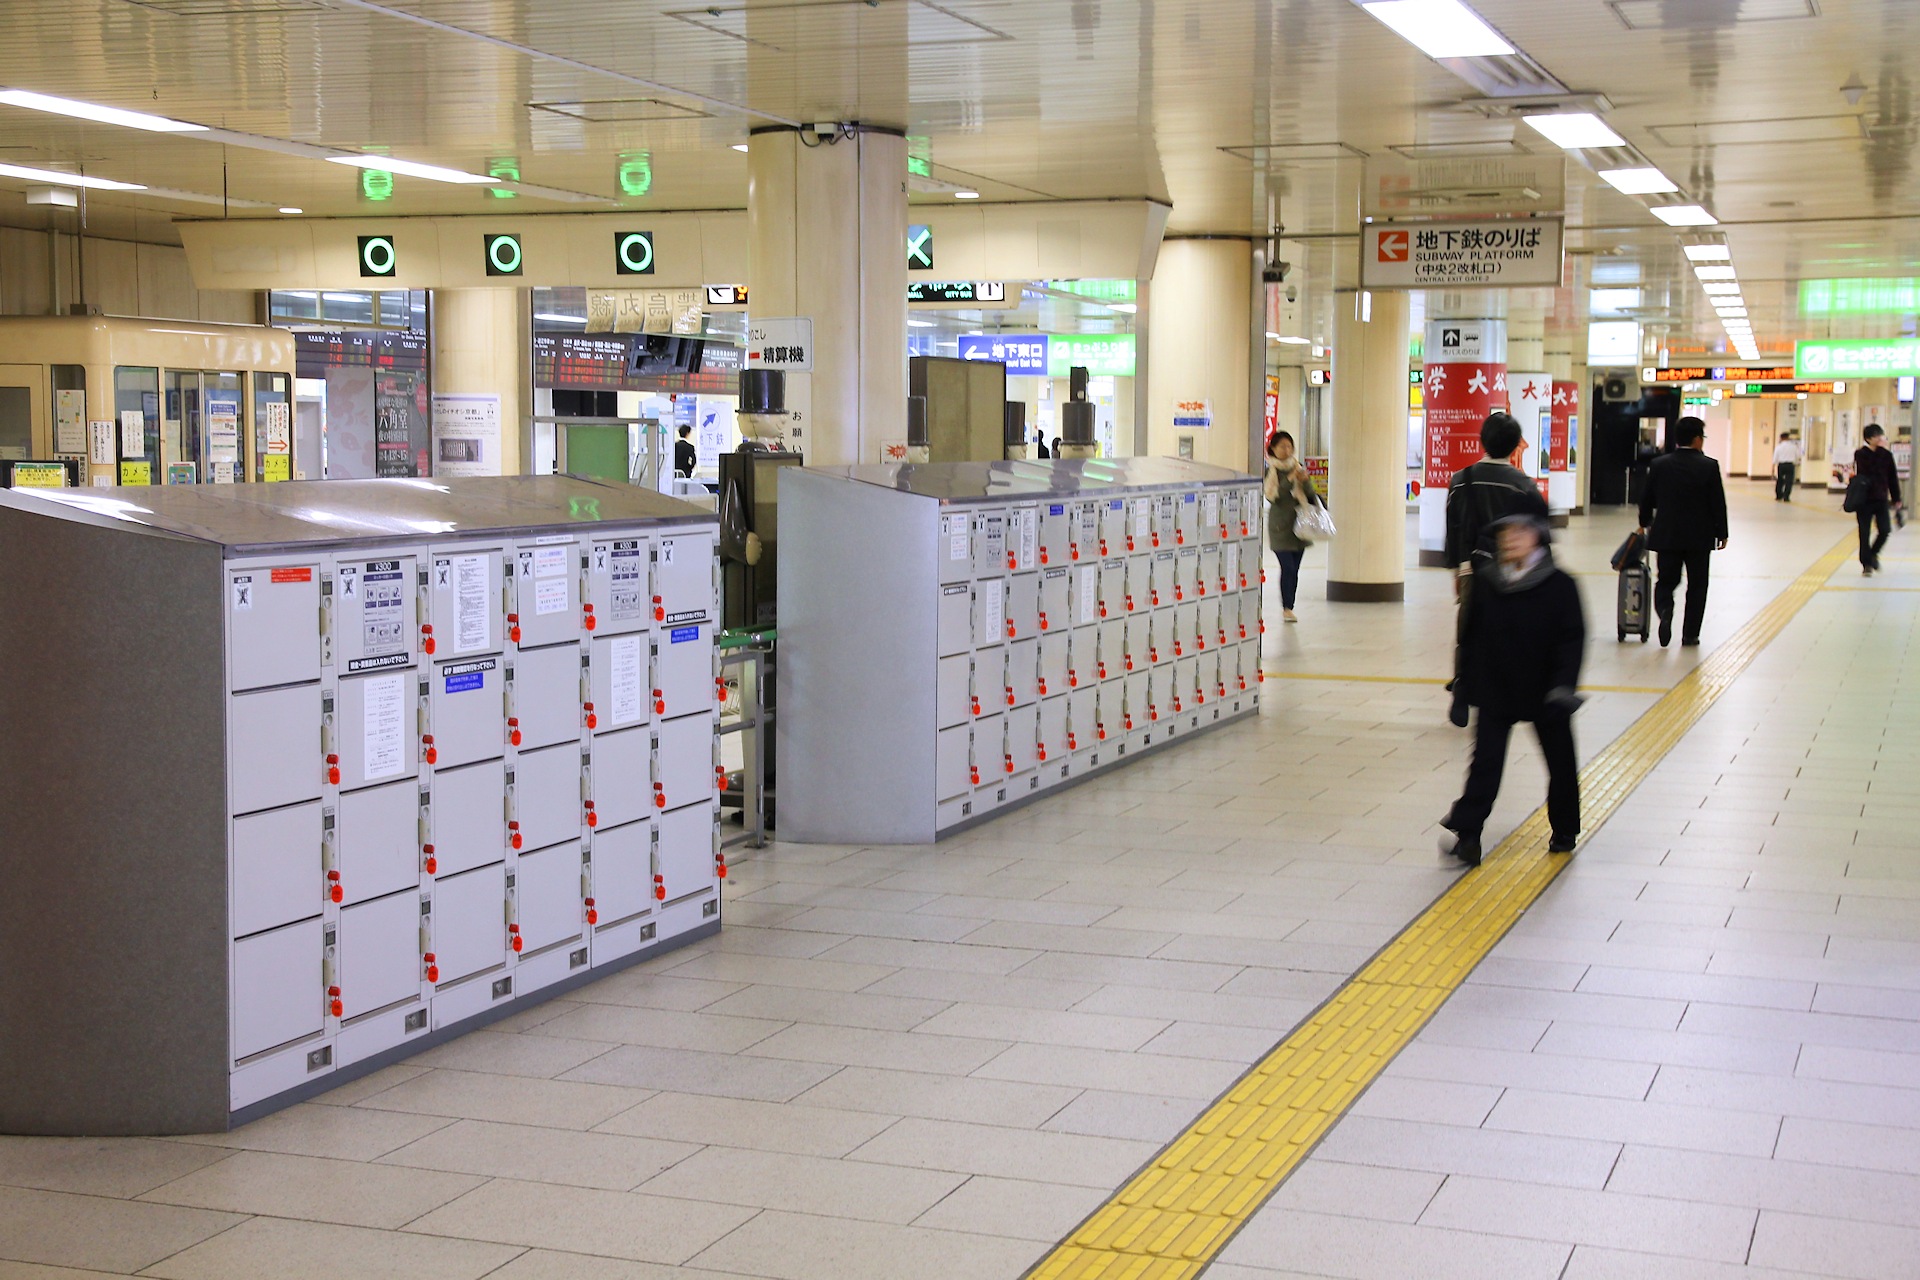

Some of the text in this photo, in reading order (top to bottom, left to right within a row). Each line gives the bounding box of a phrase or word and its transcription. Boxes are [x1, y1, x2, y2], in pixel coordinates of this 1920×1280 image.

[1416, 228, 1542, 250] 地下鉄のりば
[1416, 250, 1534, 262] SUBWAY PLATFORM
[764, 346, 804, 364] 精算機
[992, 343, 1042, 358] 地下東口
[1428, 366, 1447, 398] 学
[379, 408, 408, 429] 六角堂
[266, 459, 287, 468] カメラ
[122, 467, 148, 476] カメラ
[375, 562, 392, 571] ¥300
